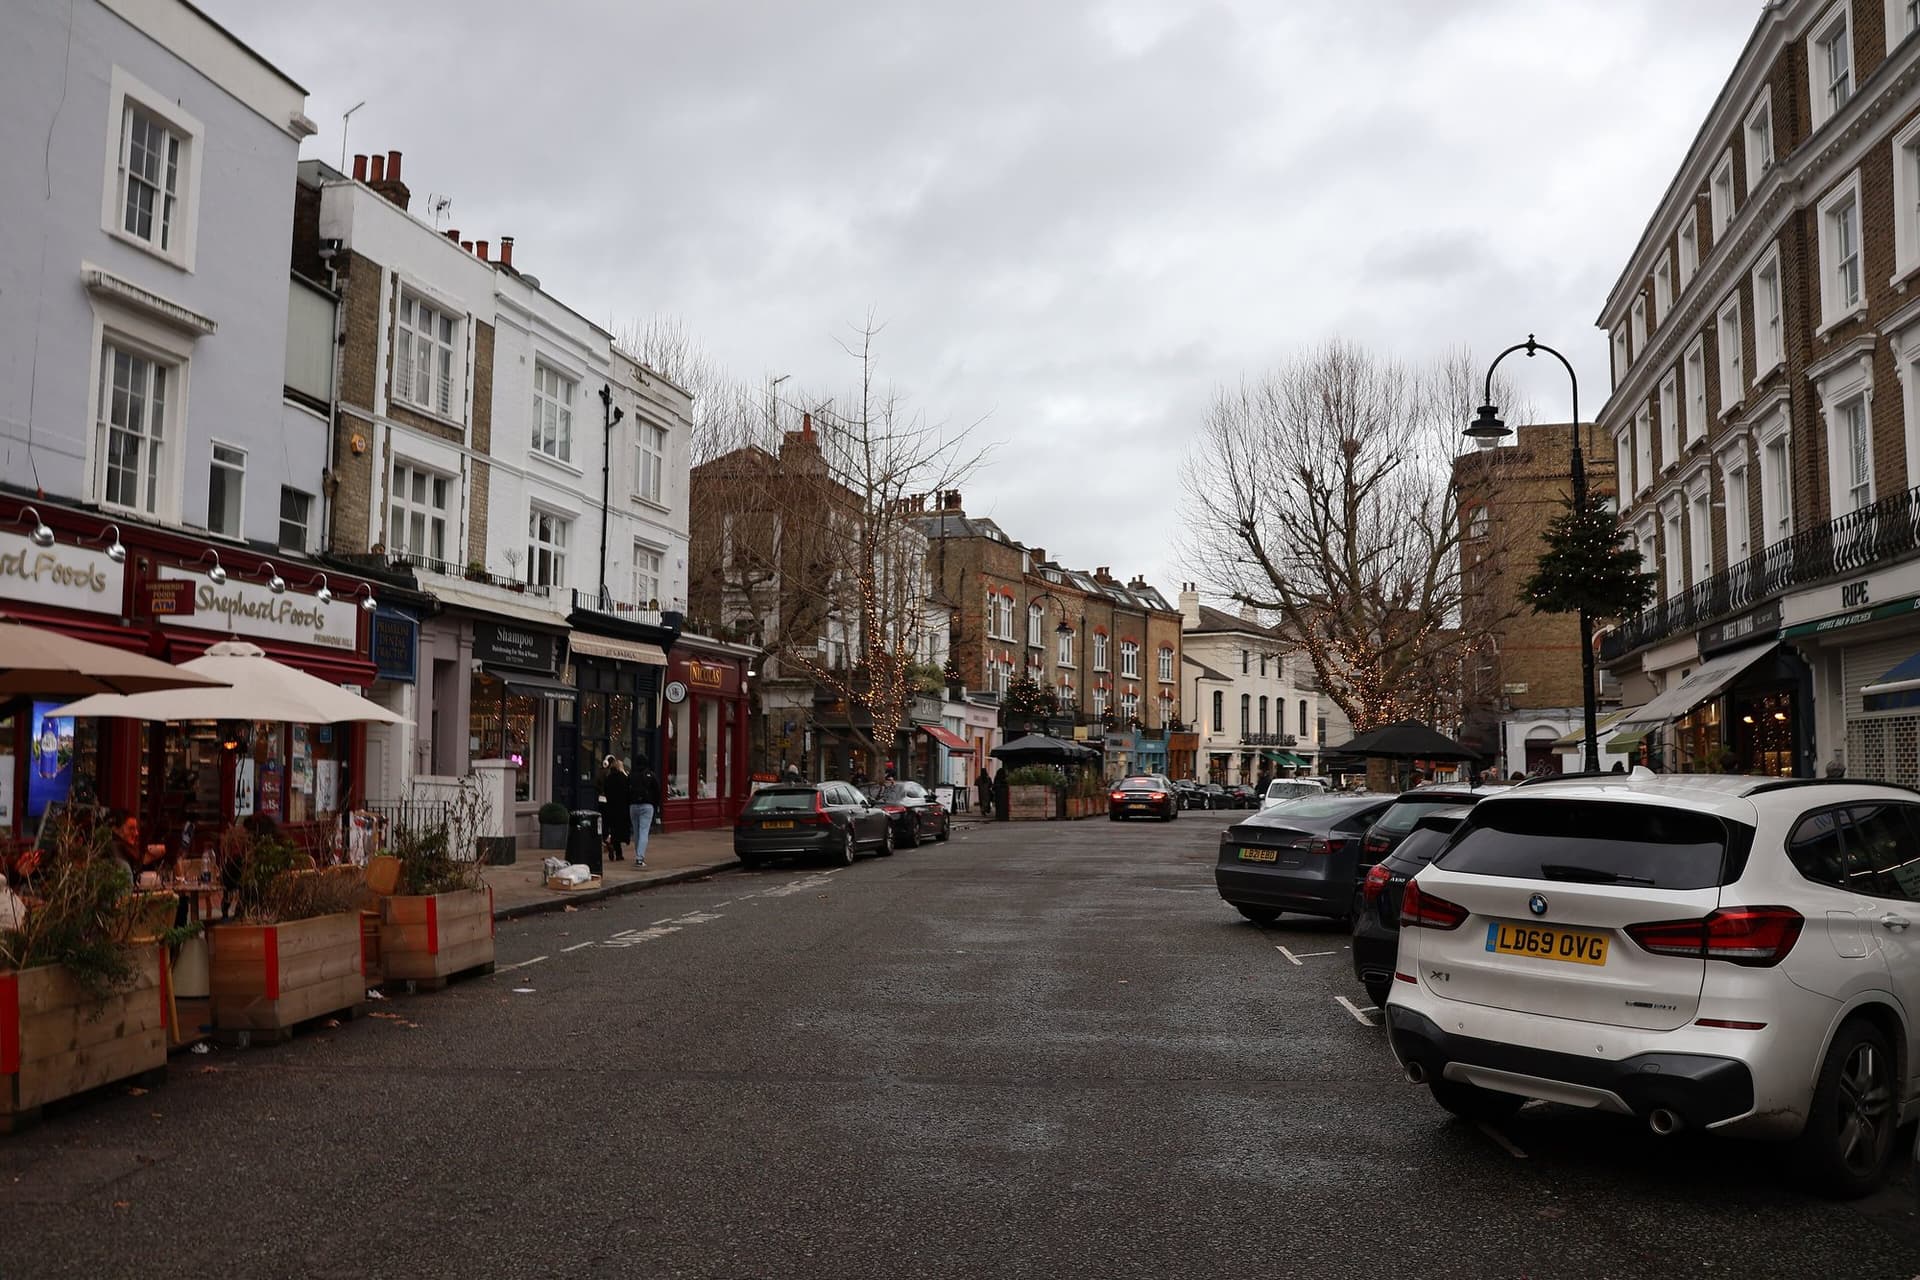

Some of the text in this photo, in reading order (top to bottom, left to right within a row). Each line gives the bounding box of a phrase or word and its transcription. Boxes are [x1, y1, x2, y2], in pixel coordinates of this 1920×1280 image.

[33, 553, 106, 593] Foods
[153, 601, 174, 609] ATM
[195, 584, 324, 630] Shepherd Foods
[1842, 580, 1869, 608] RIPE
[496, 626, 534, 649] Shampoo
[1723, 621, 1736, 641] SWEET
[1737, 615, 1753, 637] THINGS
[691, 665, 720, 683] NICOLAS
[1500, 927, 1603, 960] LD69 OVG
[1430, 970, 1450, 981] X1
